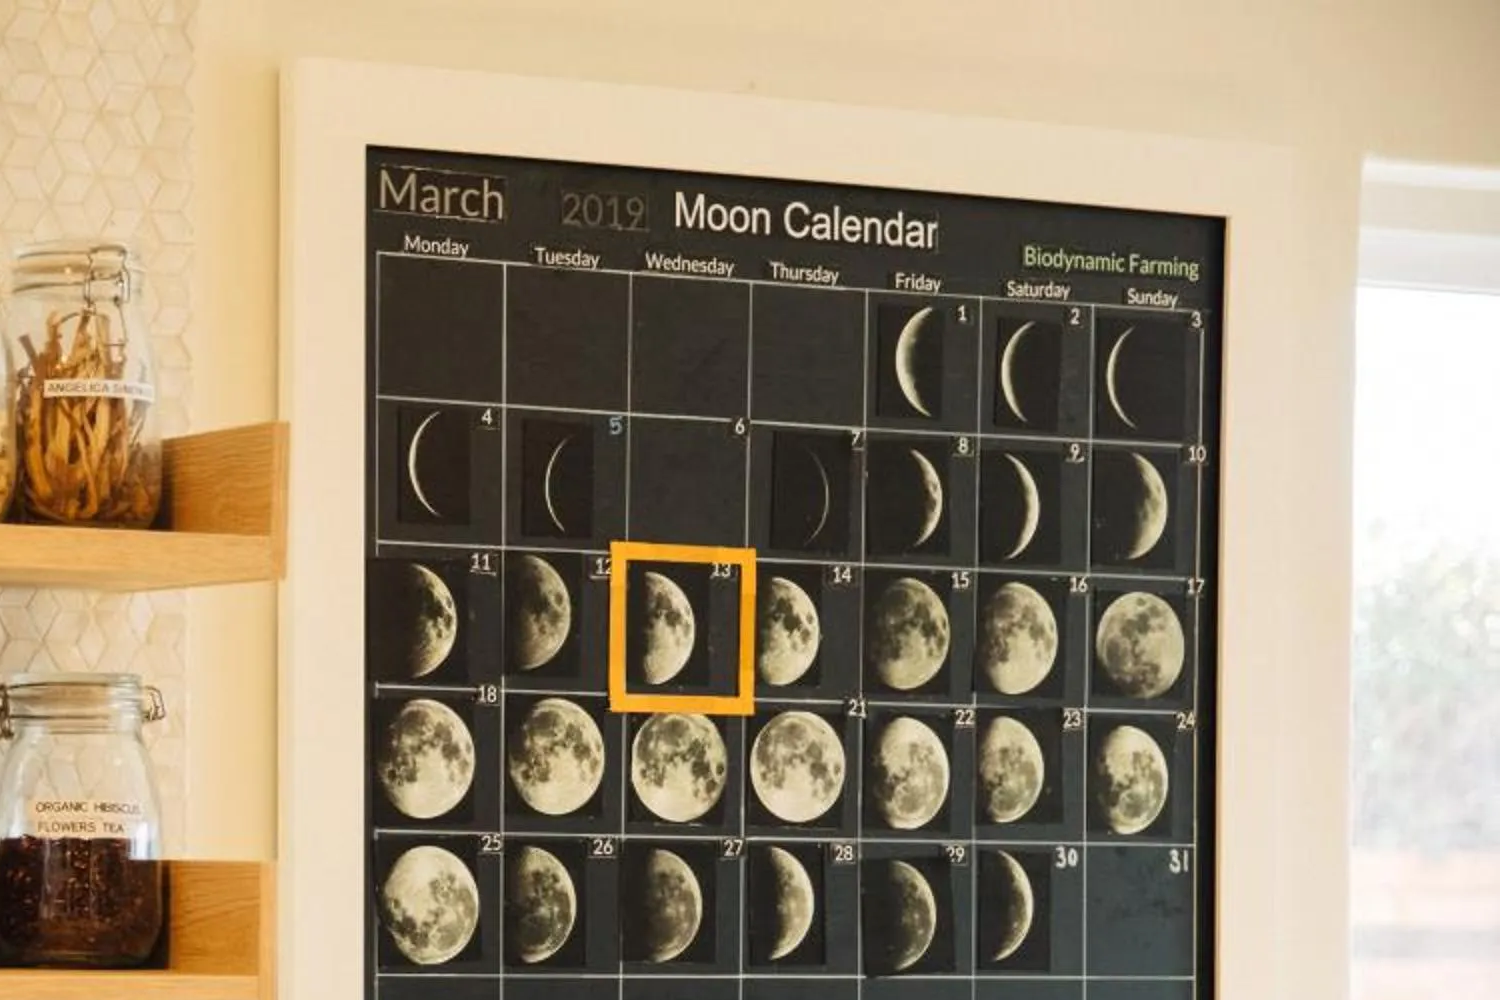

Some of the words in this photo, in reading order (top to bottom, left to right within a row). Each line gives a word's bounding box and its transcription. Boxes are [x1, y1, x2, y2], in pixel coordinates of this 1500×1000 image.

[379, 169, 505, 220] March
[561, 192, 646, 228] 2019
[674, 191, 771, 236] Moon
[783, 201, 939, 250] Calendar
[403, 234, 470, 258] Monday
[534, 247, 600, 269] Tuesday
[645, 251, 735, 278] Wednesday
[770, 261, 840, 286] Thursday
[895, 273, 942, 294] Friday
[1007, 280, 1072, 301] Saturday
[1126, 288, 1179, 309] Sunday
[1023, 246, 1126, 274] Biodynamic
[1129, 253, 1200, 282] Farming
[957, 305, 968, 322] 1
[1070, 308, 1081, 325] 2
[1191, 311, 1203, 328] 3
[480, 407, 493, 425] 4
[608, 416, 624, 436] 5
[734, 416, 746, 435] 6
[850, 430, 862, 446] 7
[956, 437, 969, 455] 8
[1069, 443, 1080, 459] 9
[1188, 445, 1206, 463] 10
[470, 552, 491, 571] 11
[710, 561, 732, 578] 13
[832, 566, 852, 584] 14
[951, 571, 970, 589] 15
[1069, 575, 1088, 593] 16
[1186, 578, 1205, 595] 17
[477, 684, 498, 704] 18
[849, 700, 867, 718] 21
[955, 709, 975, 726] 22
[1063, 710, 1082, 728] 23
[1176, 712, 1196, 730] 24
[36, 802, 88, 813] ORGANIC
[94, 802, 141, 815] HIBISCUS
[37, 821, 97, 833] FLOWERS
[103, 822, 125, 833] TEA
[481, 834, 502, 852] 25
[593, 838, 614, 856] 26
[723, 838, 743, 858] 27
[834, 845, 854, 862] 28
[947, 845, 966, 863] 29
[1055, 845, 1079, 870] 30
[1168, 848, 1190, 874] 31
